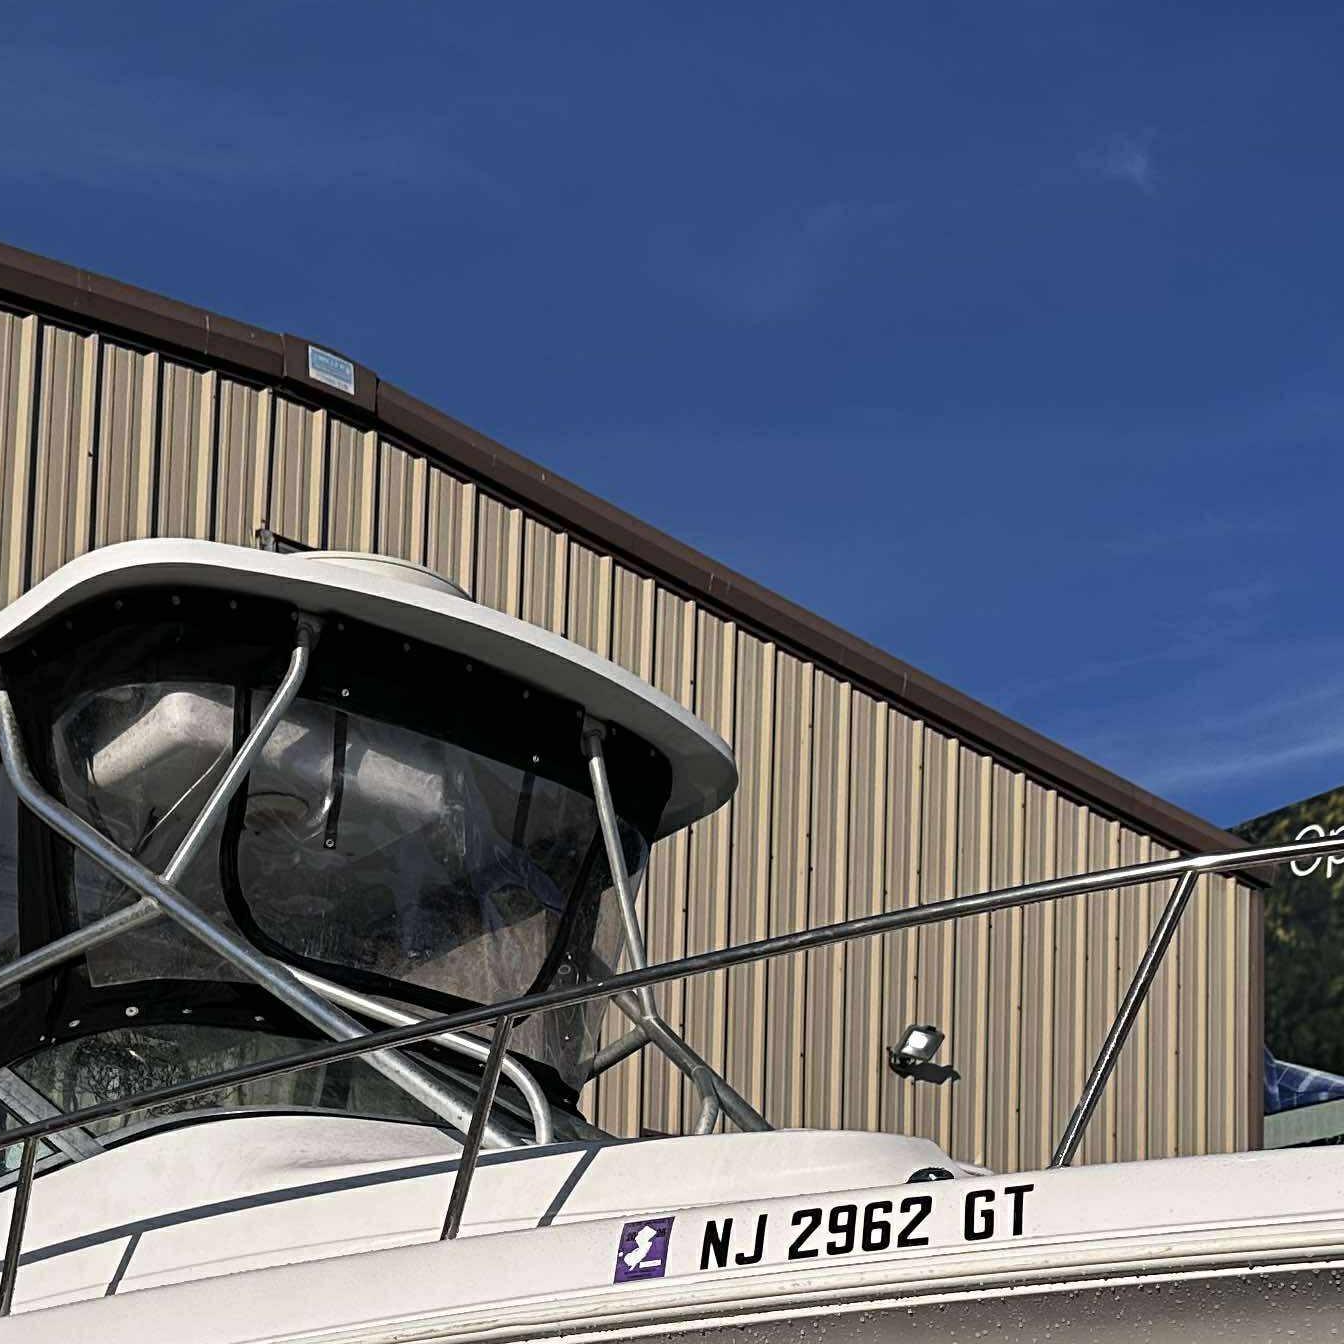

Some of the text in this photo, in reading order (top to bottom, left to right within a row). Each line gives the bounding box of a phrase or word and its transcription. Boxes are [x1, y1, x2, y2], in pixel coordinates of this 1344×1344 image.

[699, 1213, 769, 1271] NJ
[787, 1195, 934, 1261] 2962
[963, 1183, 1035, 1242] GT
